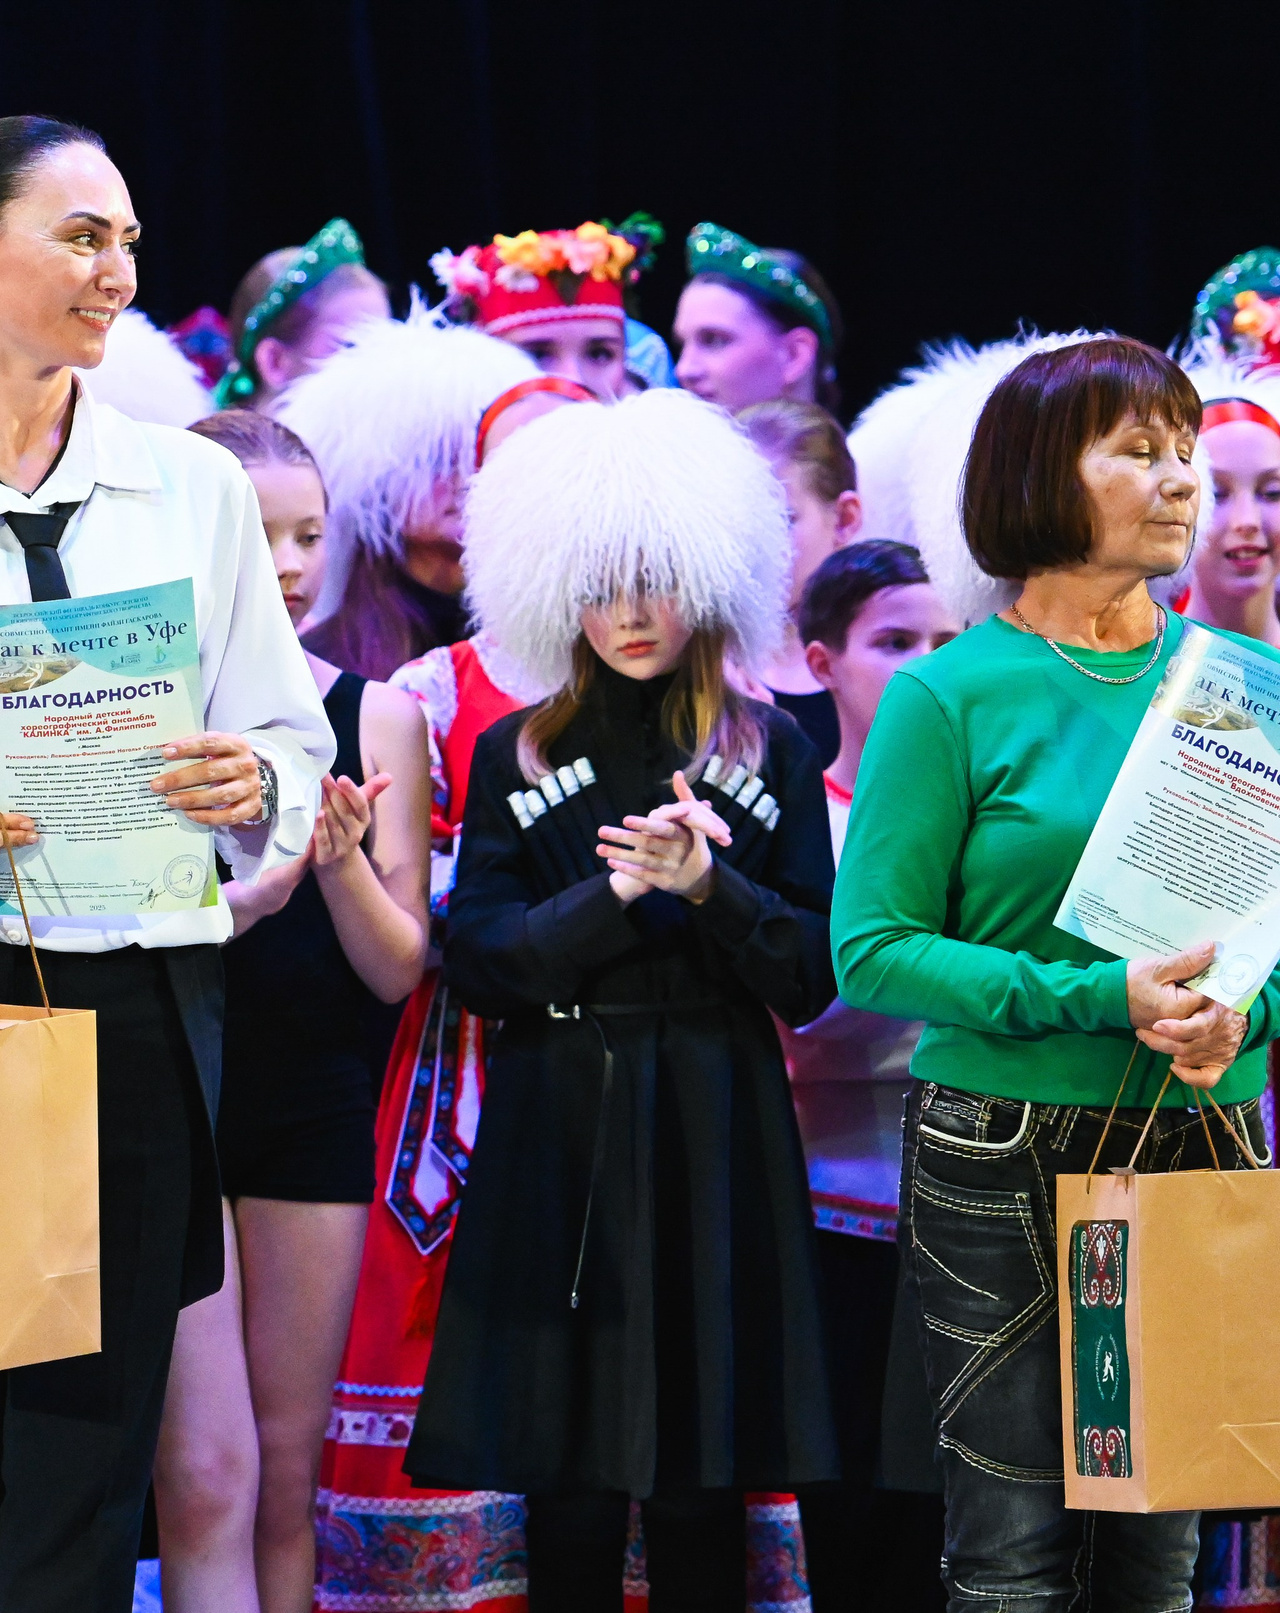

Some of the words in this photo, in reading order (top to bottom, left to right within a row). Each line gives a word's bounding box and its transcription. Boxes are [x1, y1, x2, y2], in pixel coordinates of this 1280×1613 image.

[32, 643, 44, 656] к
[53, 634, 119, 654] мечте
[127, 632, 138, 645] в
[144, 620, 188, 644] Уфе
[2, 680, 174, 709] БЛАГОДАРНОСТЬ
[1195, 676, 1216, 692] аг
[1220, 688, 1234, 702] к
[1238, 696, 1280, 724] меч
[20, 719, 108, 732] хореографический
[112, 714, 155, 724] ансамбль
[44, 713, 93, 723] Народный
[96, 708, 132, 719] детский
[96, 722, 157, 734] А.Филиппова
[1177, 750, 1221, 774] Народный
[1222, 772, 1280, 802] хореографиче
[1182, 762, 1225, 785] коллектив
[1229, 780, 1280, 810] "Вдохновени
